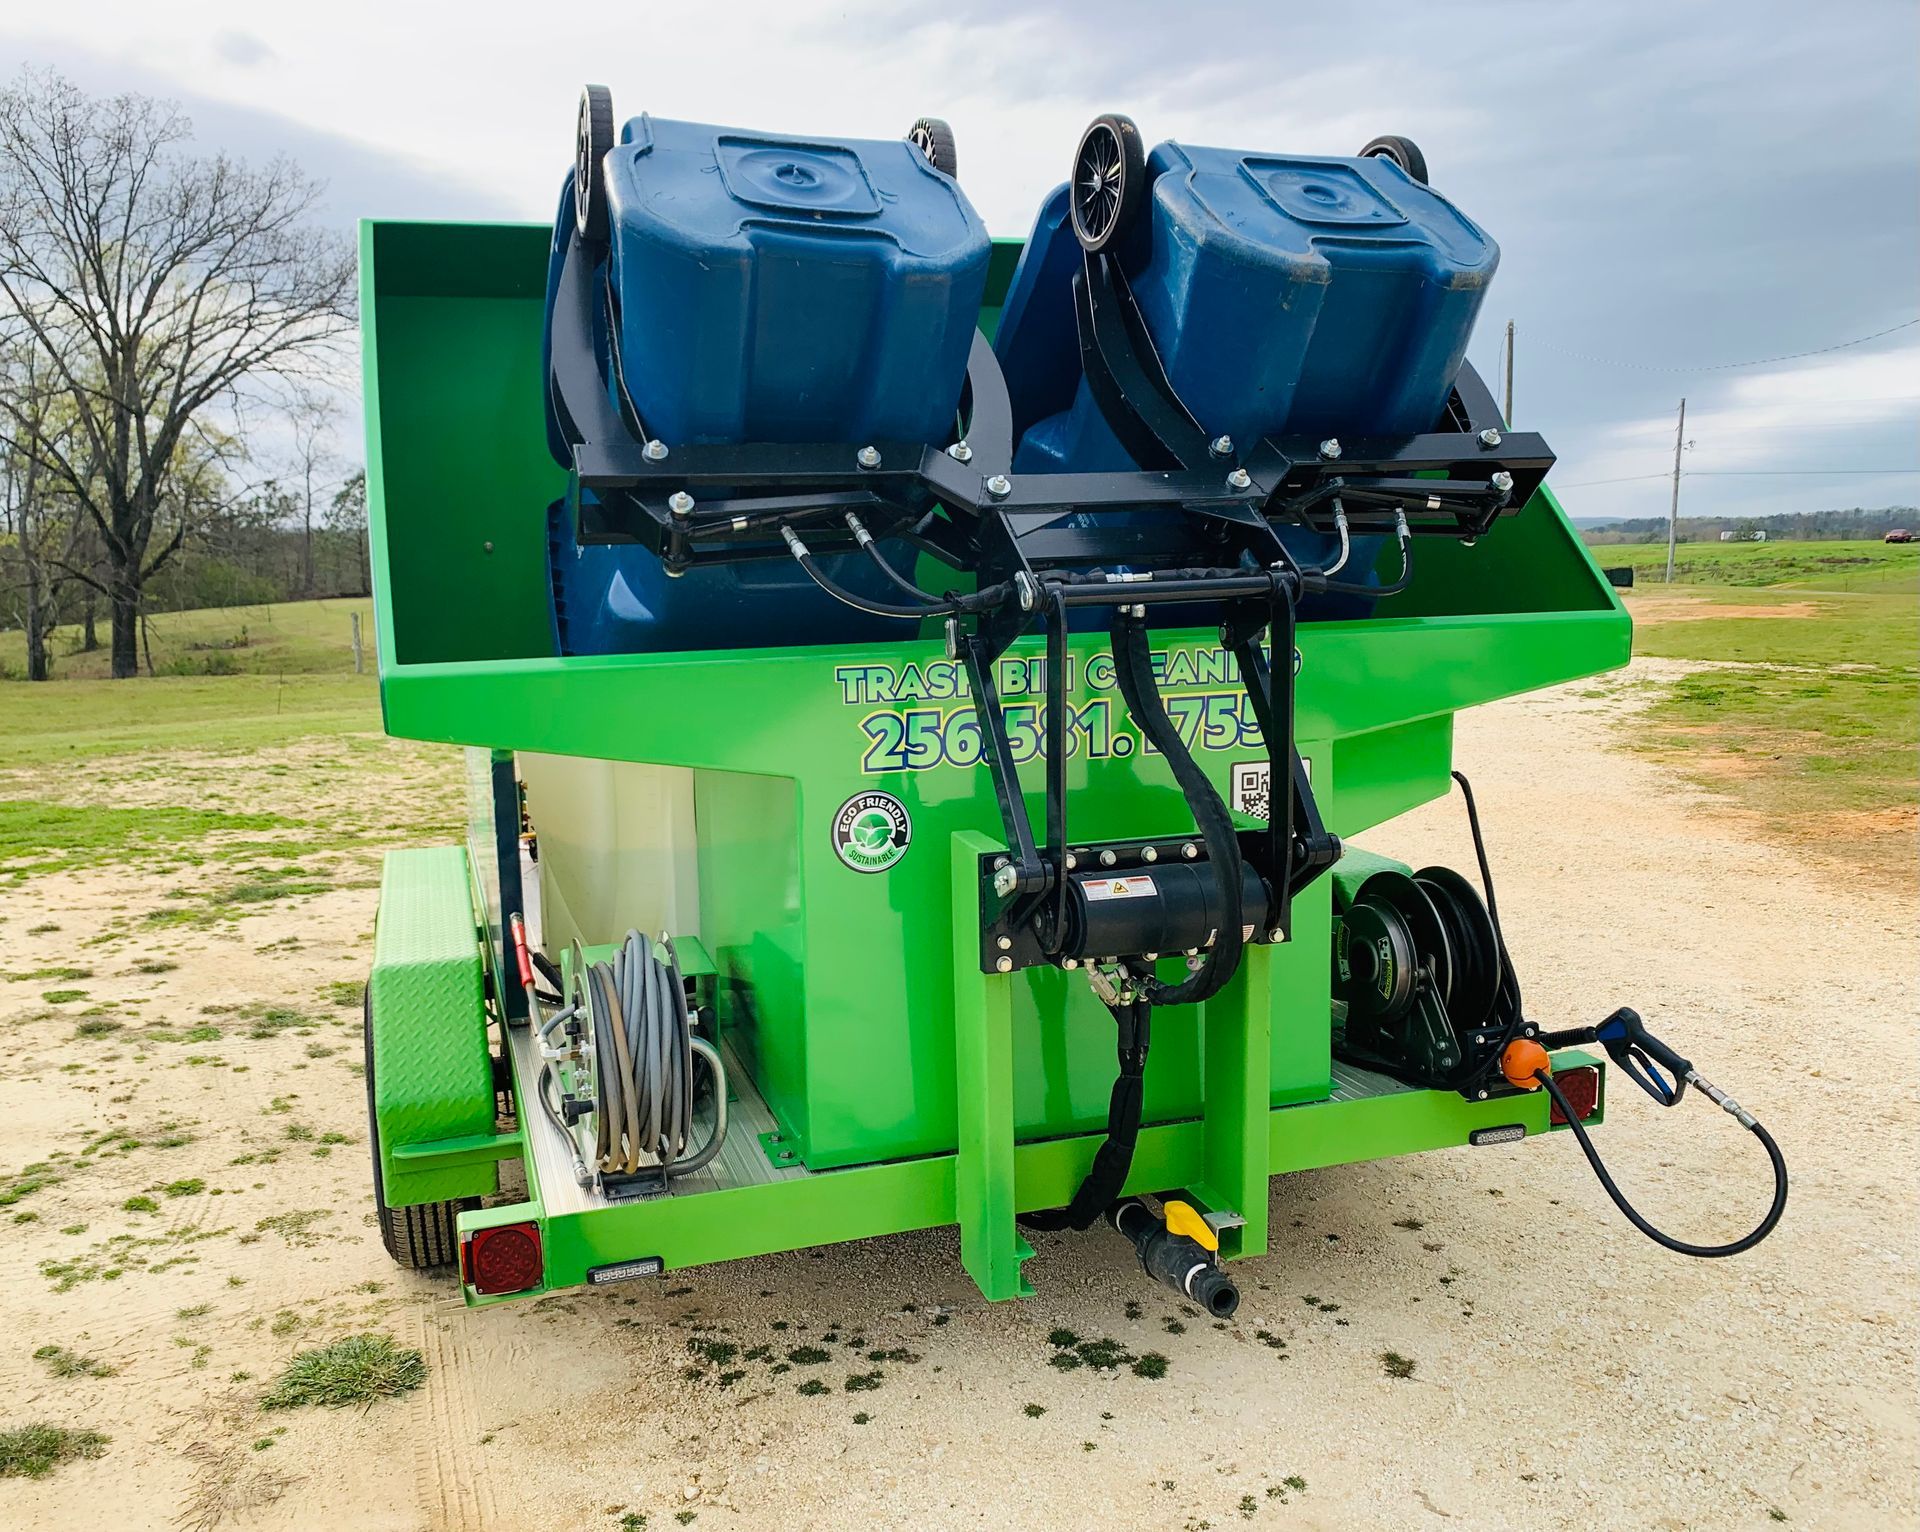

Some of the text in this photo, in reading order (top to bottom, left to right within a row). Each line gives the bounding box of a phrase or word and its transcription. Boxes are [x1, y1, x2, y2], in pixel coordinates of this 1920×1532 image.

[839, 797, 907, 833] ECO FRIENDLY
[848, 848, 896, 866] SUSTAINABLE
